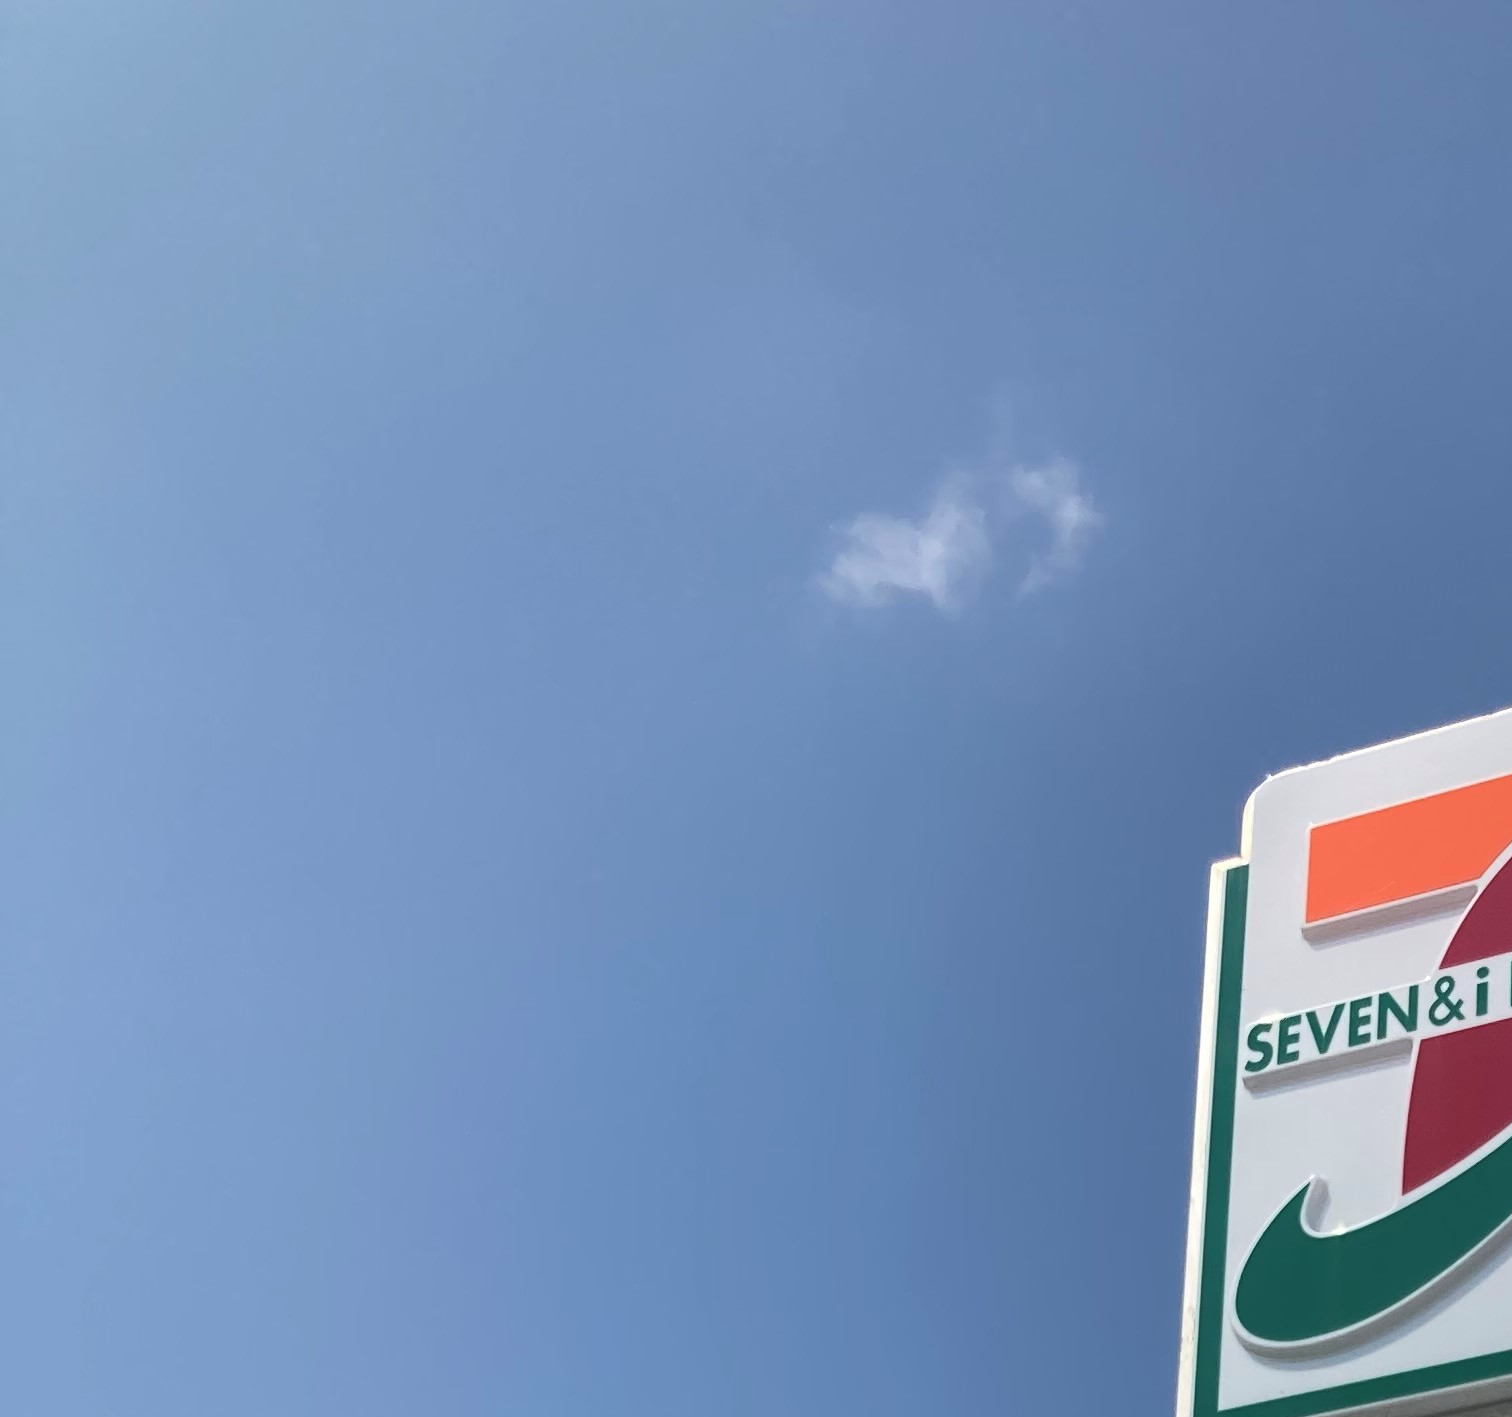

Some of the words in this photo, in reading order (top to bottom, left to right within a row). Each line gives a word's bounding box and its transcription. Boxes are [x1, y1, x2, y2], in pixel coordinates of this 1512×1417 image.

[1246, 984, 1419, 1073] SEVEN
[1428, 975, 1463, 1026] &
[1475, 966, 1490, 1016] i
